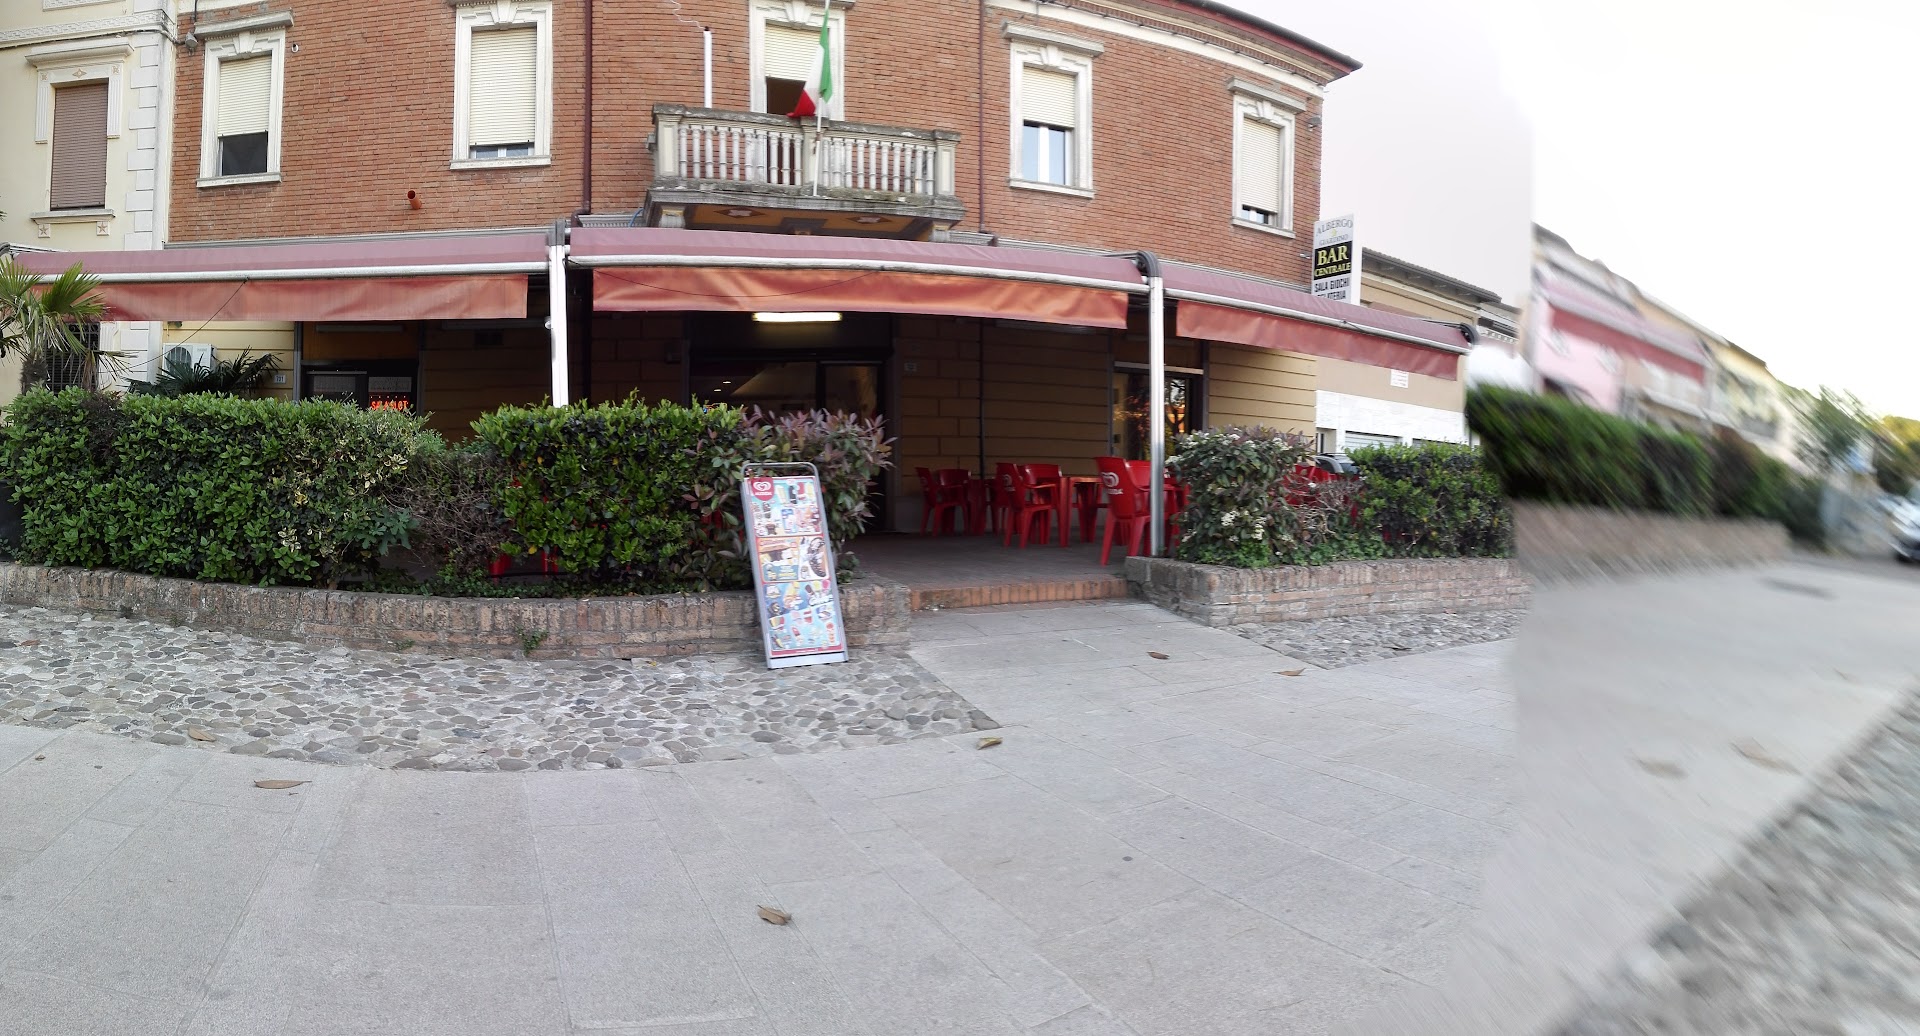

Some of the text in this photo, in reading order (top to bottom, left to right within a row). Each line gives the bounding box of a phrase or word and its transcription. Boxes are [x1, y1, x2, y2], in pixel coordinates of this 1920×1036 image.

[1316, 219, 1353, 235] ALBERGO
[1317, 245, 1349, 266] BAR
[1314, 262, 1351, 277] CENTRALE
[1315, 278, 1350, 292] SALA GIOCHI
